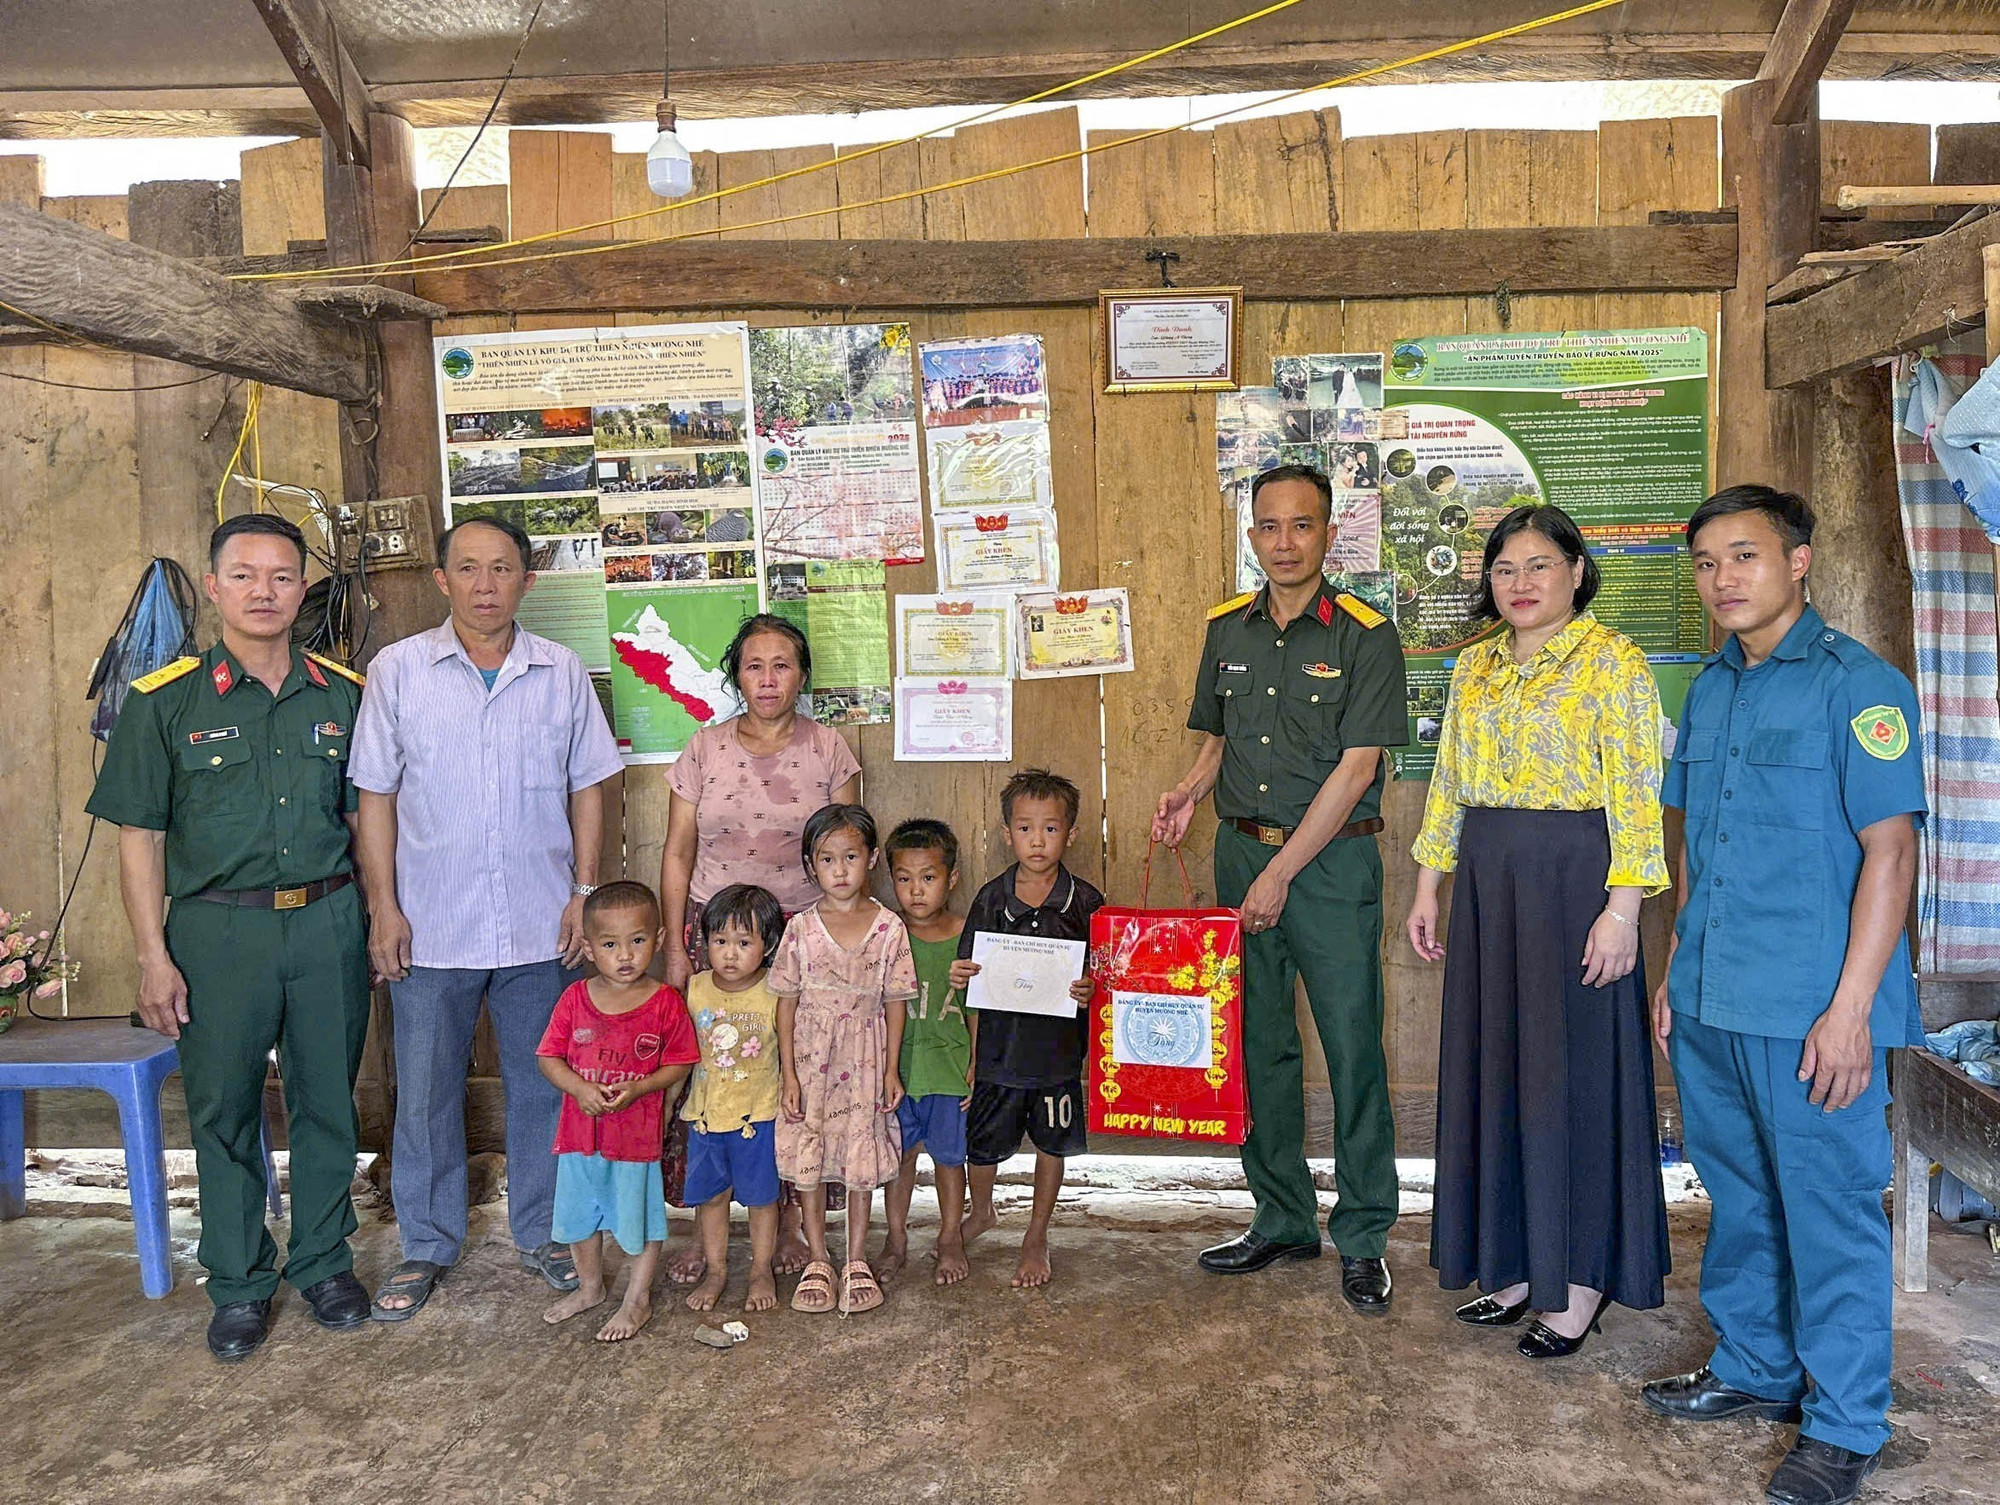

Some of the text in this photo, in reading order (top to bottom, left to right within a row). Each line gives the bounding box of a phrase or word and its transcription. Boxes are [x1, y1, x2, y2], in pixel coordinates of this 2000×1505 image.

[500, 348, 524, 358] QUẢN
[540, 347, 560, 355] KHU
[575, 344, 592, 353] TRỮ
[594, 342, 620, 352] THIÊN
[1506, 352, 1532, 360] TUYÊN
[1534, 350, 1566, 360] TRUYỀN
[1567, 350, 1582, 358] BẢO
[1584, 349, 1594, 358] VỆ
[1596, 348, 1618, 358] RỪNG
[1621, 348, 1639, 356] NĂM
[1411, 420, 1422, 429] GIÁ
[1424, 421, 1434, 429] TRỊ
[1455, 420, 1475, 428] TRỌNG
[1422, 431, 1447, 439] NGUYÊN
[1449, 430, 1467, 438] RỪNG
[1393, 507, 1426, 516] Đối với
[1390, 520, 1429, 531] đời sống
[1395, 534, 1425, 544] xã hội
[1054, 626, 1071, 635] GIẤY
[742, 1023, 762, 1032] GIRL
[598, 1048, 627, 1066] Fly
[1044, 1094, 1072, 1128] 10
[1104, 1113, 1227, 1136] HAPPY NEW YEAR
